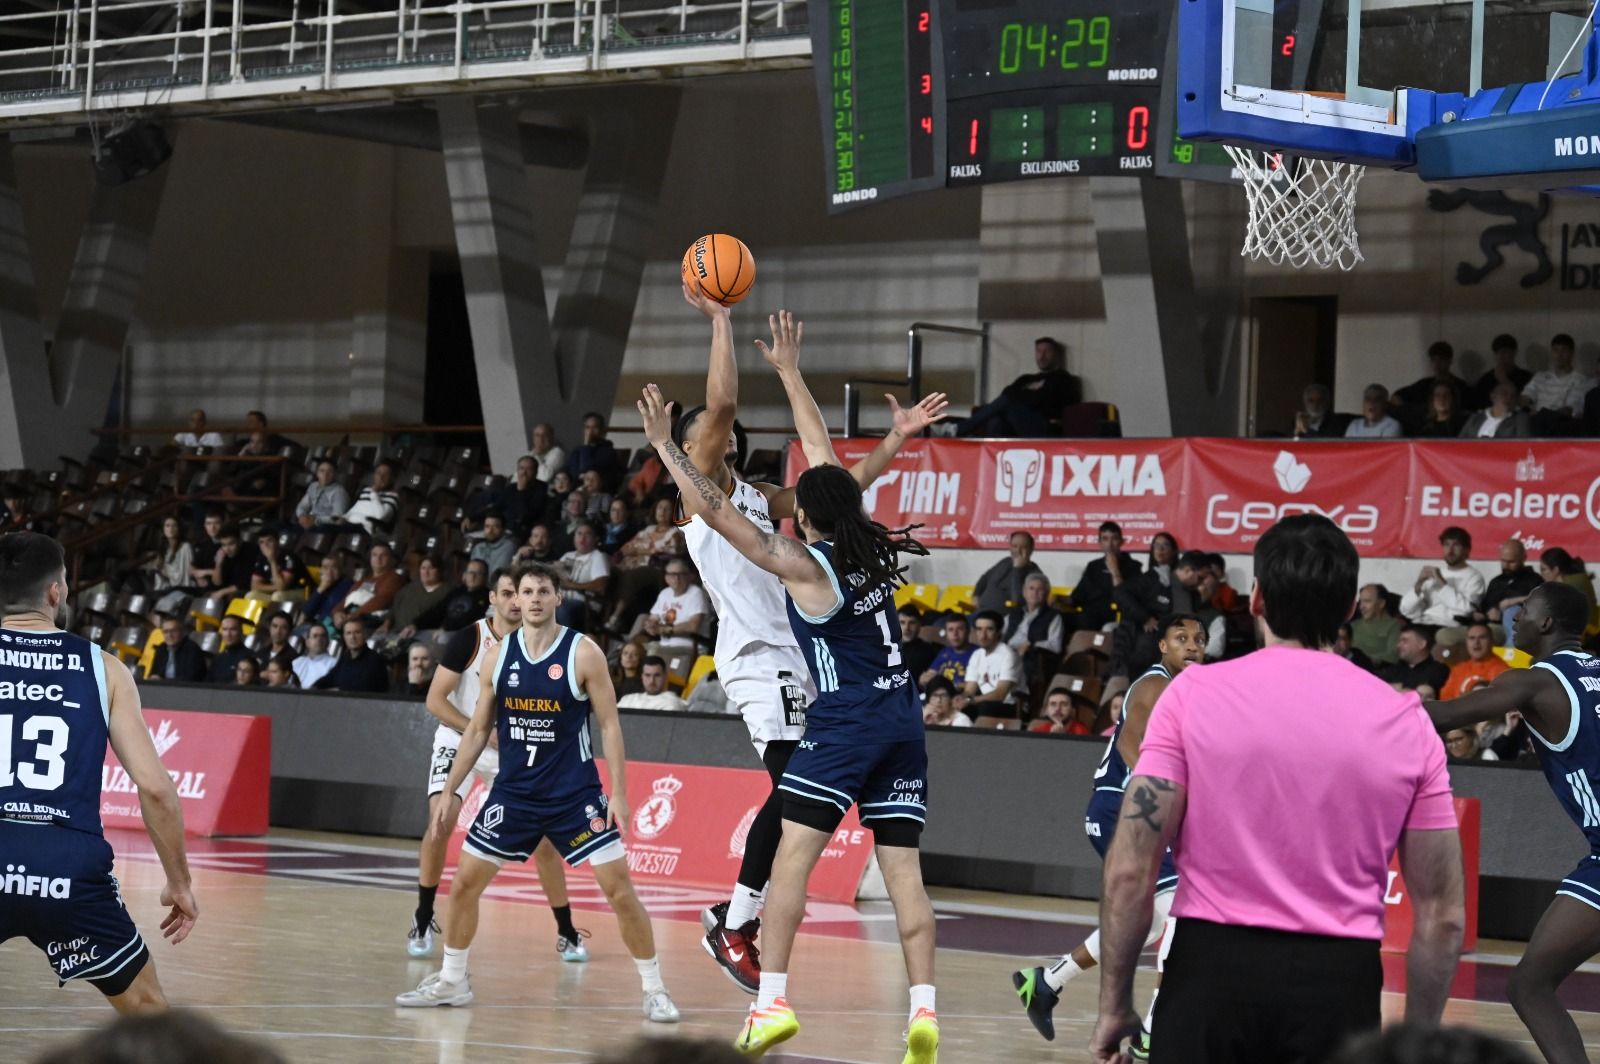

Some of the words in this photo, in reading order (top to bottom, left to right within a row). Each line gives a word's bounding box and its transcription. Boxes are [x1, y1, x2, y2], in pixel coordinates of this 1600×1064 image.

[918, 12, 929, 32] 2
[1000, 16, 1111, 74] 04:29
[1282, 35, 1295, 56] 2
[921, 74, 931, 94] 3
[1107, 68, 1158, 81] MONDO
[921, 117, 932, 134] 4
[1126, 106, 1149, 149] 0
[969, 119, 979, 155] 1
[1554, 135, 1600, 157] MON
[950, 164, 982, 178] FALTAS
[1020, 160, 1080, 175] EXCLUSIONES
[1120, 155, 1153, 169] FALTAS
[832, 187, 878, 205] MONDO
[1050, 454, 1167, 496] IXMA
[1421, 485, 1580, 519] E.Leclerc
[15, 636, 62, 647] Enerthy
[875, 610, 902, 667] 1
[67, 654, 85, 672] D.
[504, 697, 561, 712] ALIMERKA
[518, 717, 551, 729] OVIEDO
[526, 728, 555, 739] Asturias
[0, 713, 69, 791] 13
[526, 744, 538, 767] 7
[893, 778, 923, 791] Grupo
[888, 792, 925, 804] CARA
[3, 802, 32, 812] CAJA
[33, 804, 71, 819] RURAL
[47, 936, 90, 956] Grupo
[52, 945, 101, 974] ARAC
